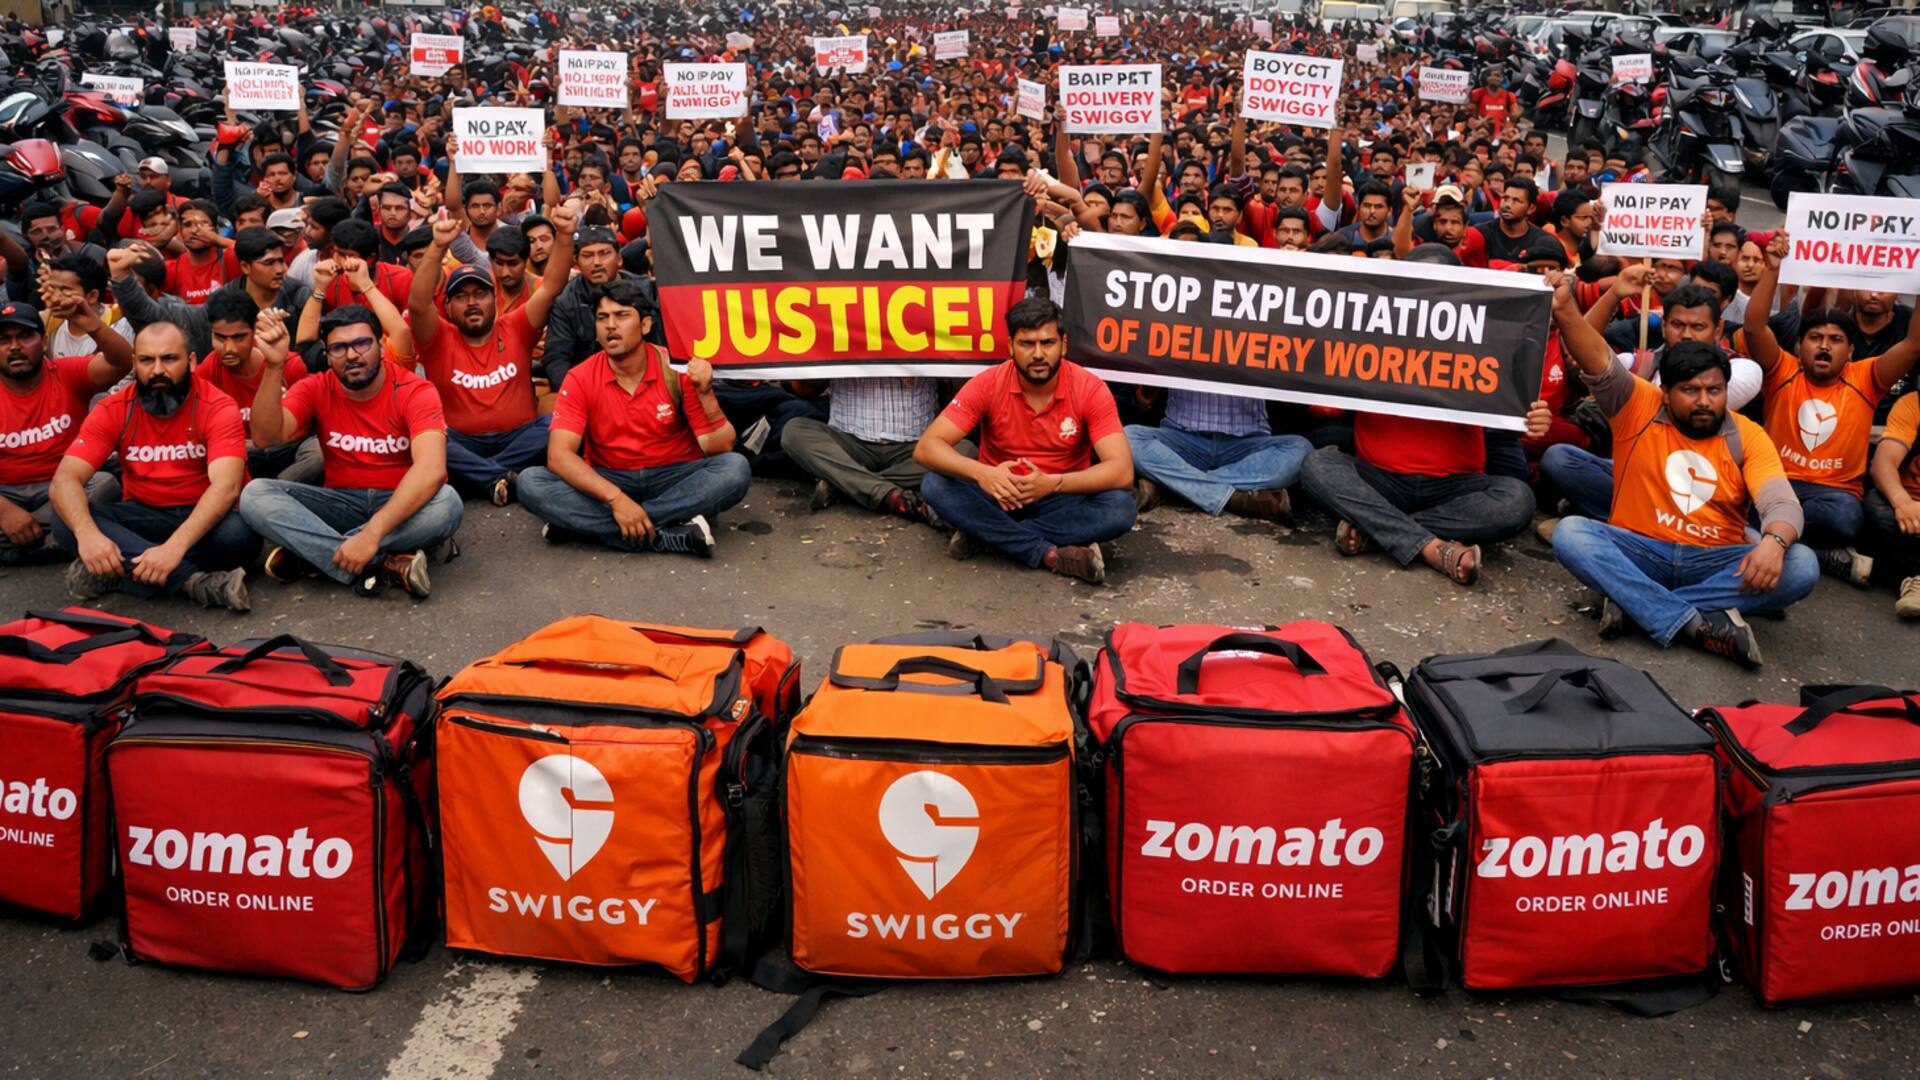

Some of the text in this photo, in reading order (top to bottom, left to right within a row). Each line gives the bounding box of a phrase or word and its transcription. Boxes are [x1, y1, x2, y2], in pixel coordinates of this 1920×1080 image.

[1066, 91, 1154, 106] DOLIVERY
[1249, 78, 1333, 99] DOYCITY
[1071, 110, 1152, 124] SWIGGY
[1247, 96, 1329, 117] SWIGGY
[468, 120, 490, 136] NO
[462, 140, 538, 157] NO WORK
[1608, 214, 1697, 230] NOLIVERY
[677, 213, 995, 273] WE WANT
[1104, 268, 1487, 344] STOP EXPLOITATION
[693, 285, 995, 359] JUSTICE!
[1096, 317, 1499, 394] OF DELIVERY WORKERS
[451, 362, 518, 389] zomato
[125, 441, 206, 462] zomato
[326, 431, 409, 454] zomato
[0, 777, 77, 820] ato
[128, 825, 353, 880] zomato
[1141, 817, 1384, 867] zomato
[1477, 817, 1705, 878] zomato
[166, 886, 314, 911] ORDER ONLINE
[1181, 878, 1344, 899] ORDER ONLINE
[1515, 887, 1669, 912] ORDER ONLINE
[488, 887, 656, 925] SWIGGY
[847, 911, 1022, 940] SWIGGY
[1820, 922, 1882, 941] ORDER
